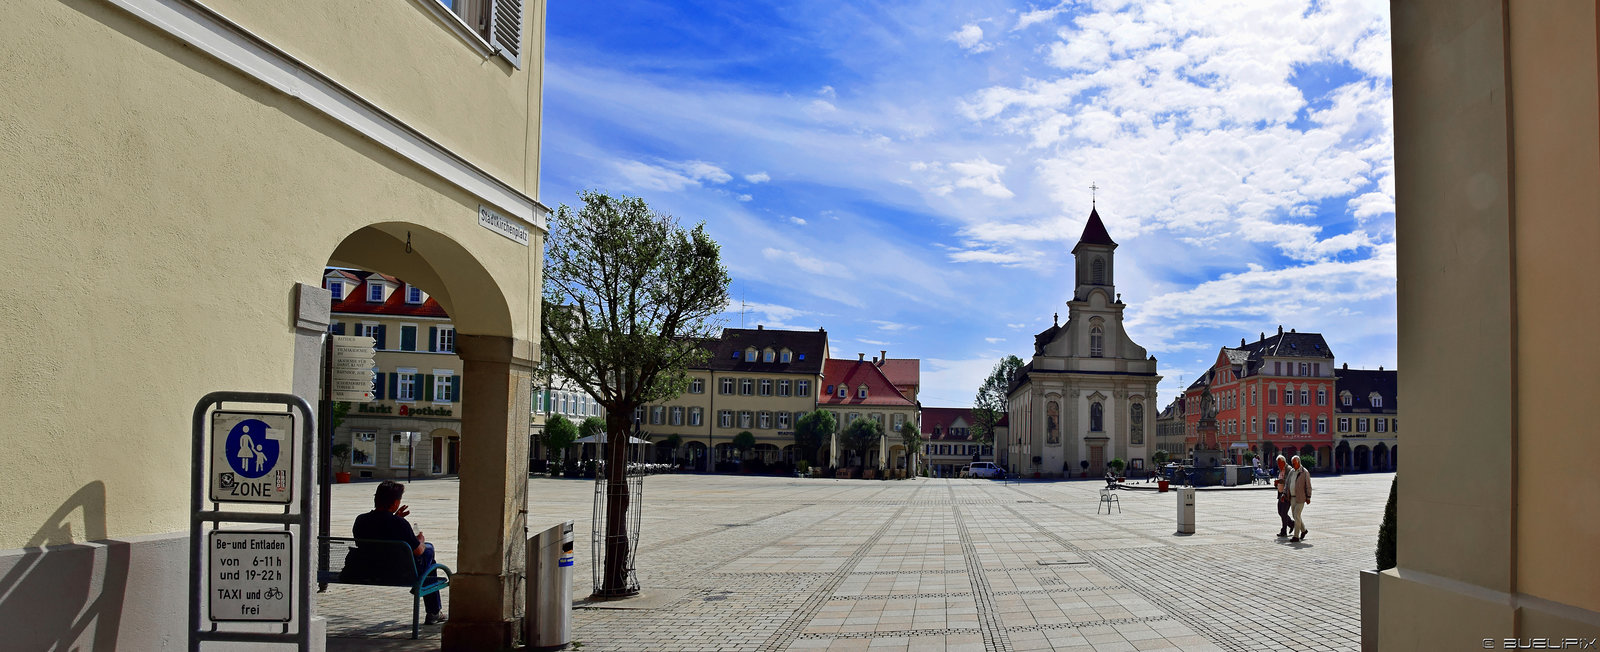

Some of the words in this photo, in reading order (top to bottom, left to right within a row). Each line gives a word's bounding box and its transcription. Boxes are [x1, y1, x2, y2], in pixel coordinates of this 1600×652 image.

[481, 209, 528, 242] Stadtkirchenplatz
[359, 404, 392, 413] Markt
[399, 405, 452, 417] Apotheke
[230, 482, 272, 497] ZONE
[250, 539, 285, 551] Entladen
[220, 558, 240, 566] von
[252, 556, 273, 567] 6-11
[276, 556, 282, 567] h
[220, 570, 240, 580] und
[245, 570, 274, 580] 19-22
[276, 570, 282, 580] h
[218, 589, 242, 600] TAXI
[246, 589, 261, 600] und
[241, 604, 260, 615] frei
